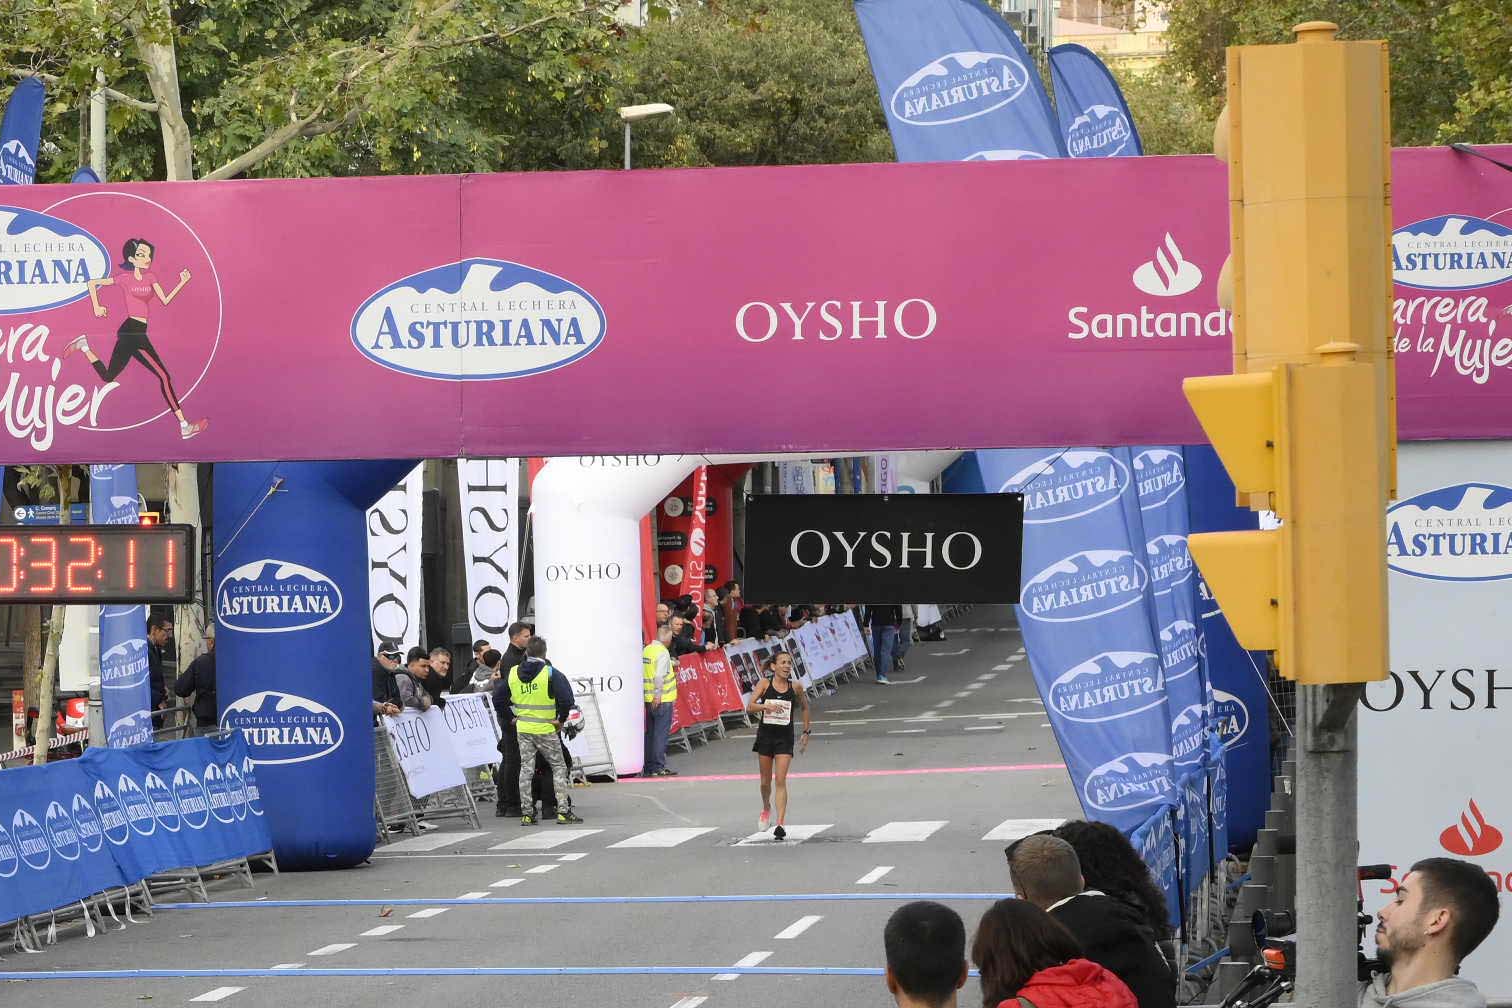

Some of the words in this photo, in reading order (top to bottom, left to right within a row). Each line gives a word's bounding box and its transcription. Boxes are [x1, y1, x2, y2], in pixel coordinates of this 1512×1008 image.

[14, 242, 85, 253] LECHERA
[410, 301, 487, 314] CENTRAL
[496, 299, 578, 313] LECHERA
[1393, 296, 1488, 324] arrera
[371, 306, 586, 350] ASTURIANA
[735, 299, 937, 343] OYSHO
[1068, 305, 1233, 340] Santand
[1417, 327, 1434, 353] la
[1431, 320, 1512, 384] Muje
[1415, 518, 1480, 527] CENTRAL
[790, 529, 982, 570] OYSHO
[546, 562, 621, 582] OYSHO
[233, 585, 275, 593] CENTRAL
[281, 584, 328, 592] LECHERA
[221, 589, 333, 616] ASTURIANA
[520, 682, 538, 694] Life
[576, 675, 623, 694] SHO
[1359, 668, 1512, 712] OYSH
[281, 716, 329, 724] LECHERA
[222, 725, 334, 745] TURIANA
